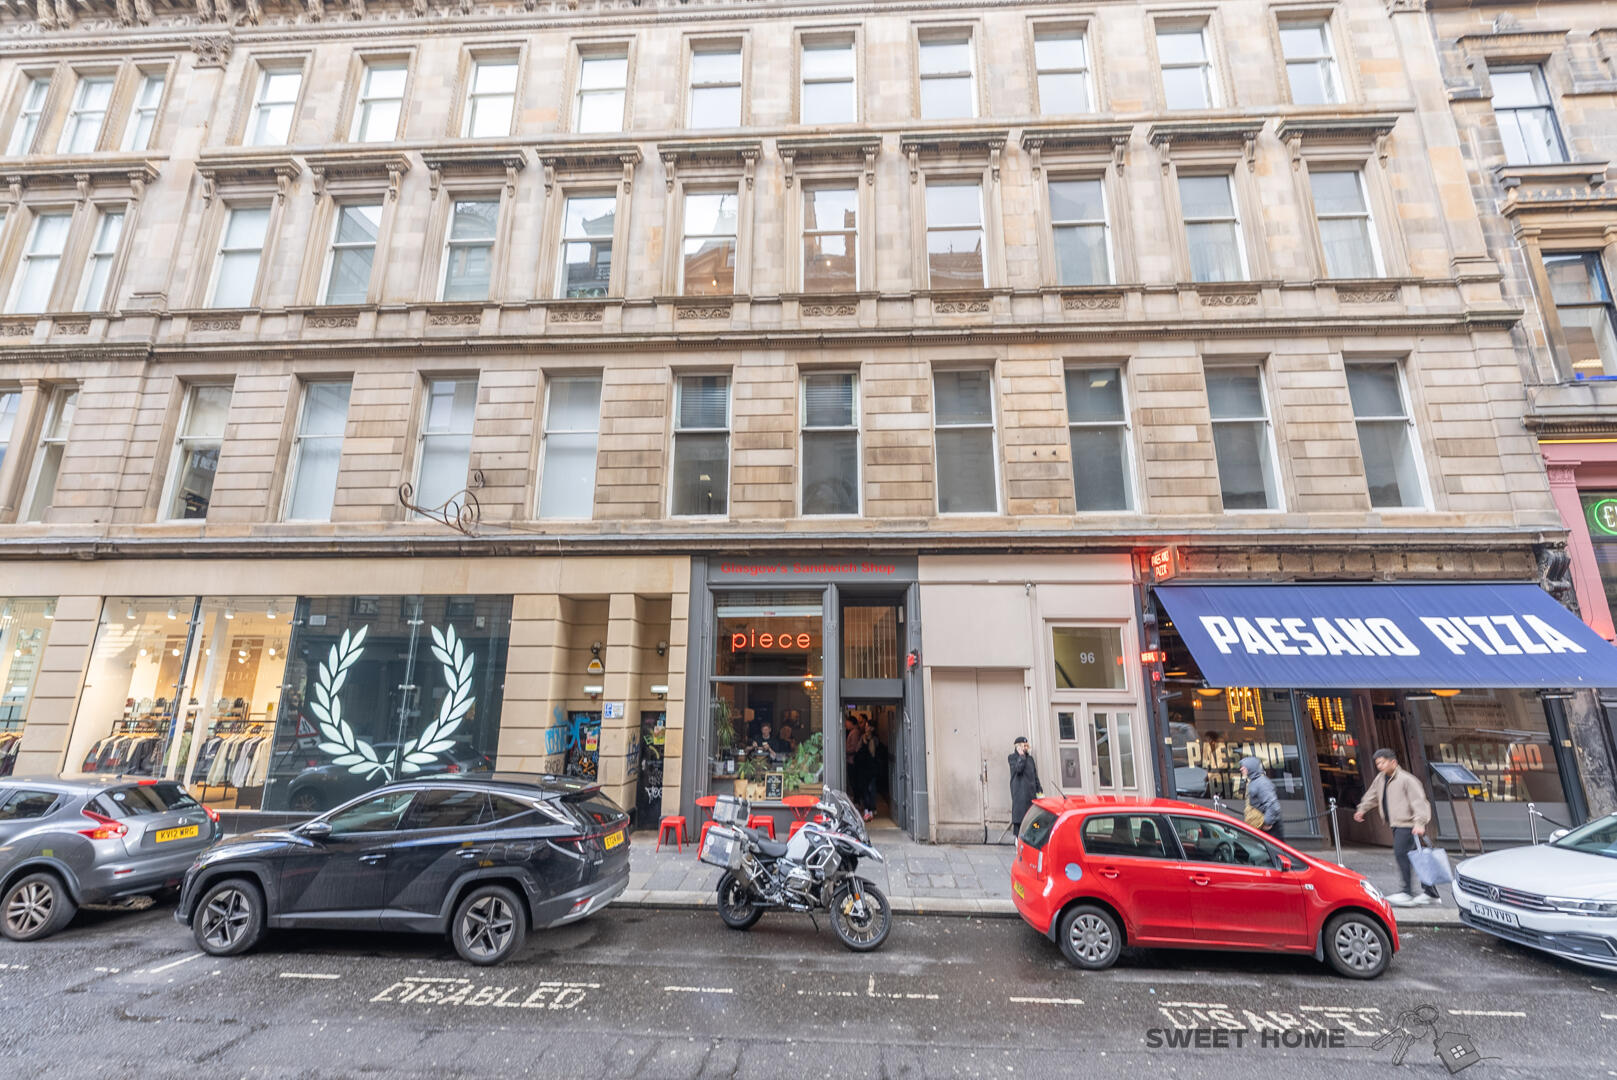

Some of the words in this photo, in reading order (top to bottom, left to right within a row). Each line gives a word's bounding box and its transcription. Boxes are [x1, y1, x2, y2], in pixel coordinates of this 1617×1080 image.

[721, 562, 788, 576] Glasgow's
[793, 561, 857, 574] Sandwich
[861, 561, 896, 576] Shop
[732, 628, 811, 653] piece
[1199, 615, 1421, 657] PAESANO
[1419, 614, 1587, 655] PIZZA
[1080, 651, 1095, 664] 96
[1186, 741, 1285, 769] PAESANO
[369, 982, 587, 1010] DISABLED
